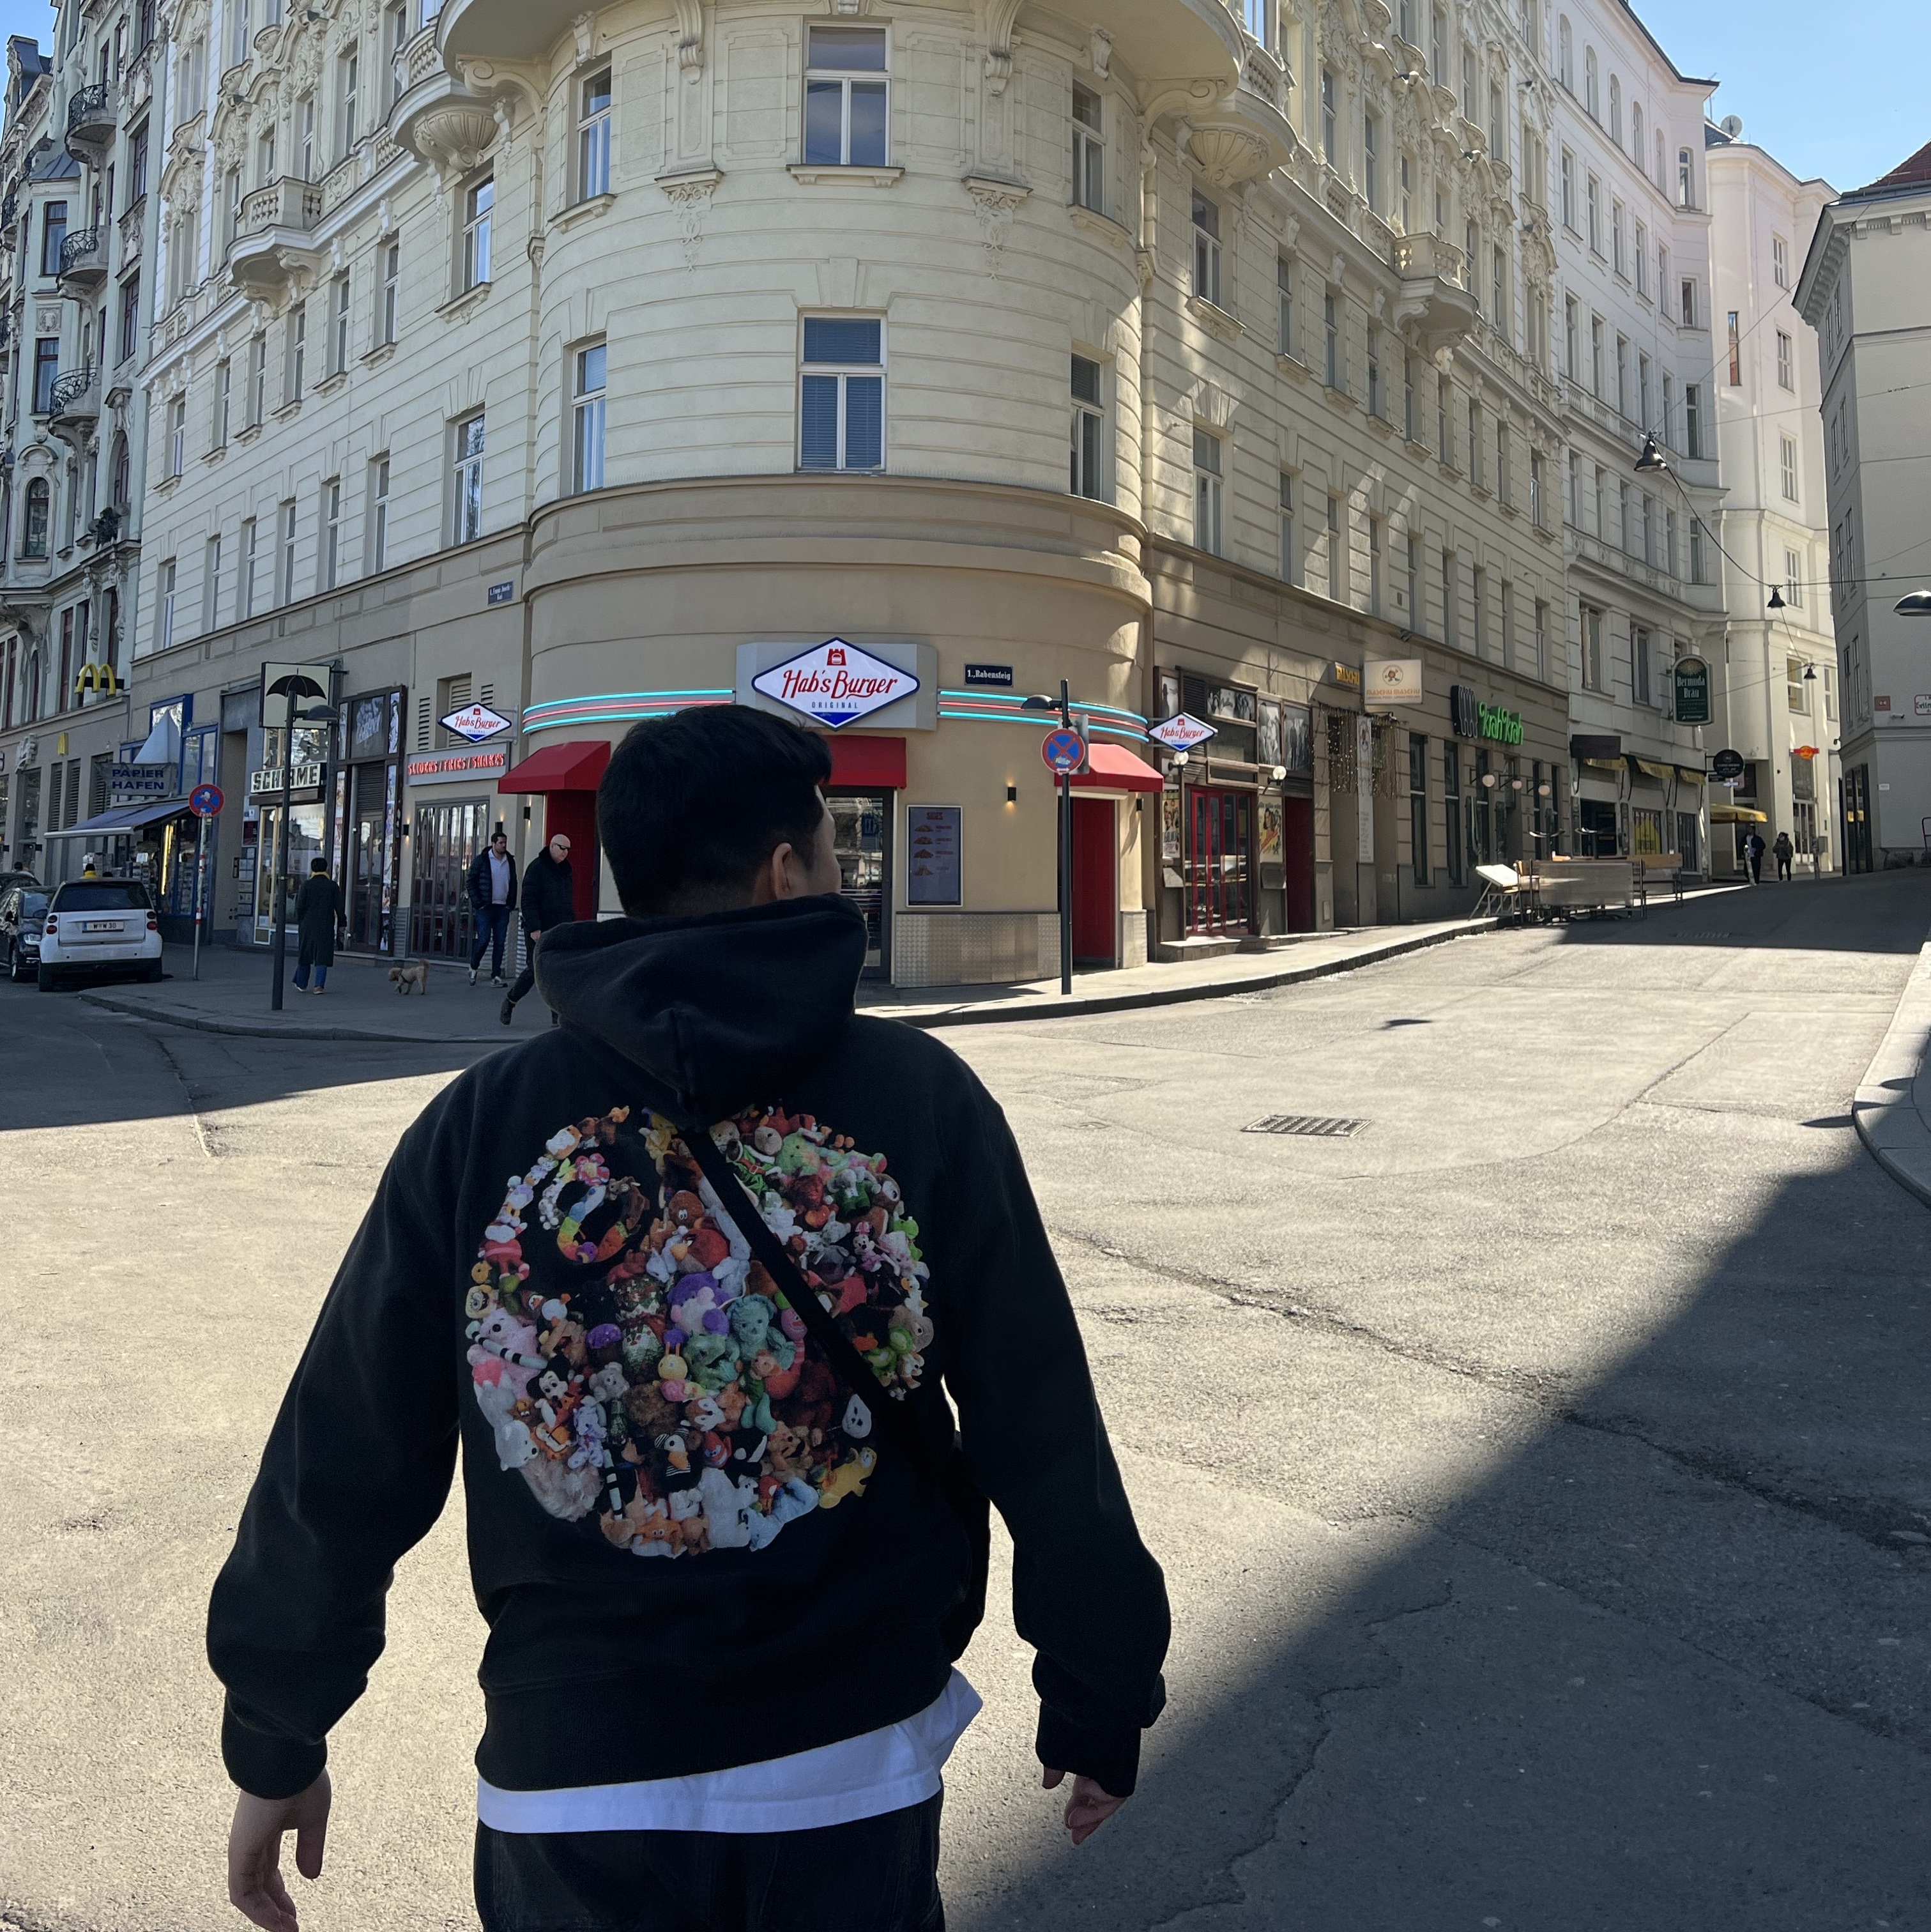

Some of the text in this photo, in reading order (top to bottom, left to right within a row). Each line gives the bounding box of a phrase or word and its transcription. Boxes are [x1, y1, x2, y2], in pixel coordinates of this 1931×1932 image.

[781, 670, 897, 700] Hab's Burger
[1677, 675, 1705, 687] Bermuda
[454, 716, 501, 730] Hab's Burger
[1160, 727, 1205, 739] Hab's Burger
[408, 760, 438, 776] SLIDERS
[443, 757, 466, 772] FRIES
[472, 753, 504, 768] SHAKES
[112, 769, 164, 778] PAPIER
[112, 781, 164, 790] HAFEN
